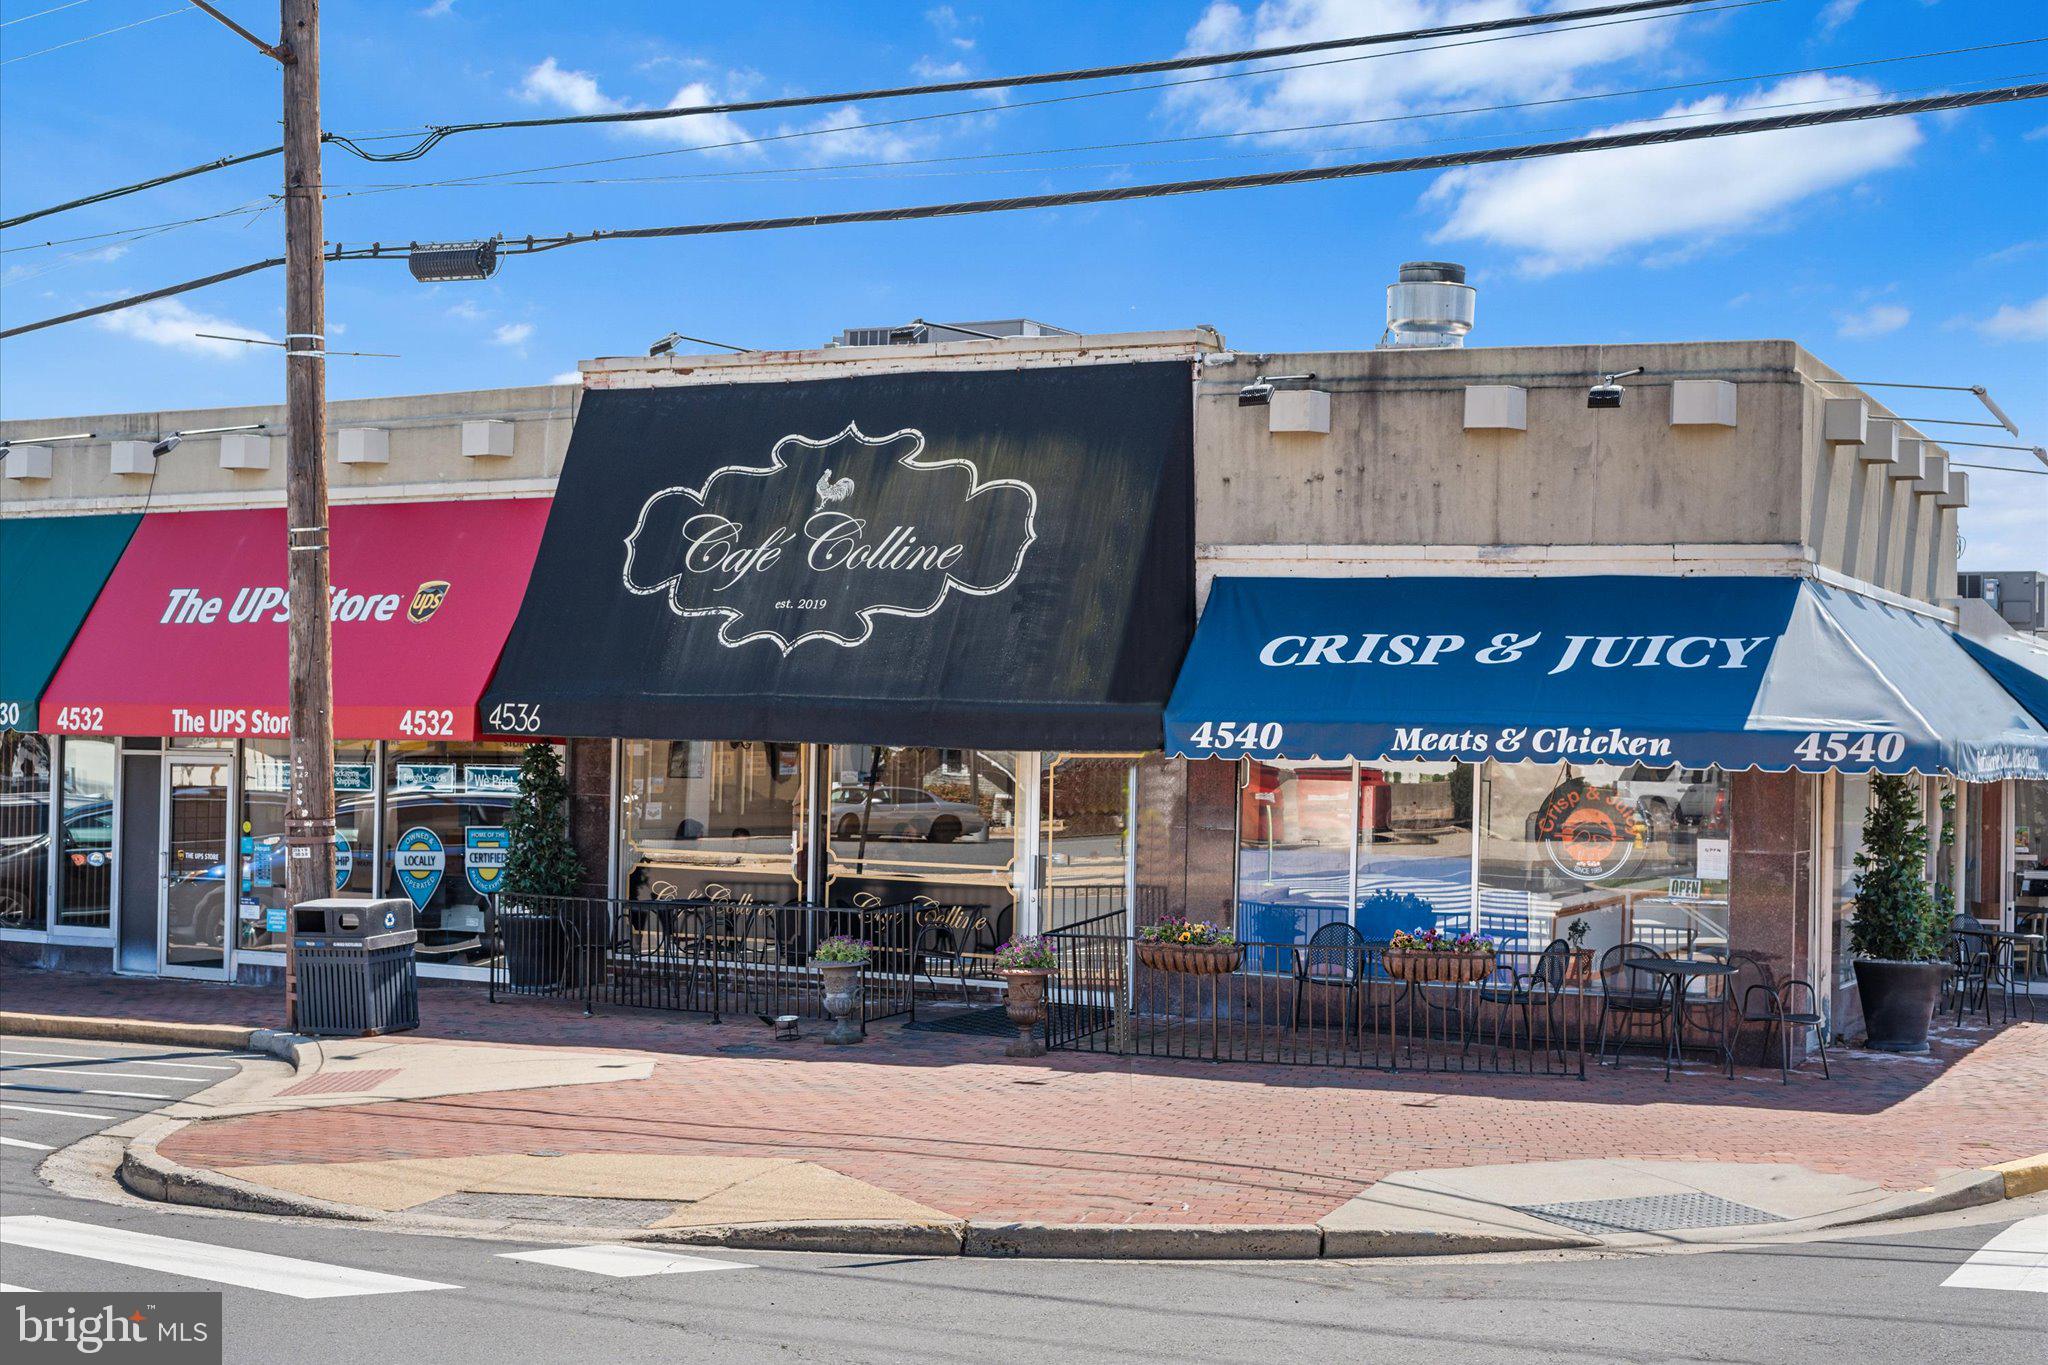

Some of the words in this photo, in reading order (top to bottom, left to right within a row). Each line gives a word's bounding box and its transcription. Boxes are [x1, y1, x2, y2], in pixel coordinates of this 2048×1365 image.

[682, 513, 796, 592] Café
[804, 512, 964, 572] Colline
[160, 589, 222, 623] The
[329, 586, 400, 622] tore
[412, 592, 442, 615] ups
[775, 599, 794, 609] est.
[797, 599, 827, 609] 2019
[1260, 634, 1466, 667] CRISP
[1474, 632, 1542, 665] &
[1548, 636, 1770, 675] JUICY
[57, 707, 104, 731] 4532
[172, 709, 204, 733] The
[209, 709, 246, 734] UPS
[251, 710, 291, 734] Stor
[399, 709, 453, 736] 4532
[489, 703, 541, 732] 4536
[1190, 721, 1284, 750] 4540
[1391, 728, 1489, 753] Meats
[1494, 727, 1529, 752] &
[1531, 728, 1672, 757] Chicken
[1793, 733, 1905, 763] 4540
[334, 769, 359, 779] ackaging
[336, 777, 361, 787] Shipping
[424, 774, 448, 782] Services
[474, 774, 490, 787] We
[492, 775, 514, 787] Print
[1538, 791, 1580, 832] Crisp
[1585, 786, 1600, 800] &
[405, 832, 429, 845] OWNED
[195, 852, 204, 860] UPS
[404, 855, 436, 866] LOCALLY
[469, 852, 507, 864] CERTIFIED
[404, 876, 436, 889] OPERATED
[1671, 880, 1700, 896] OPEN
